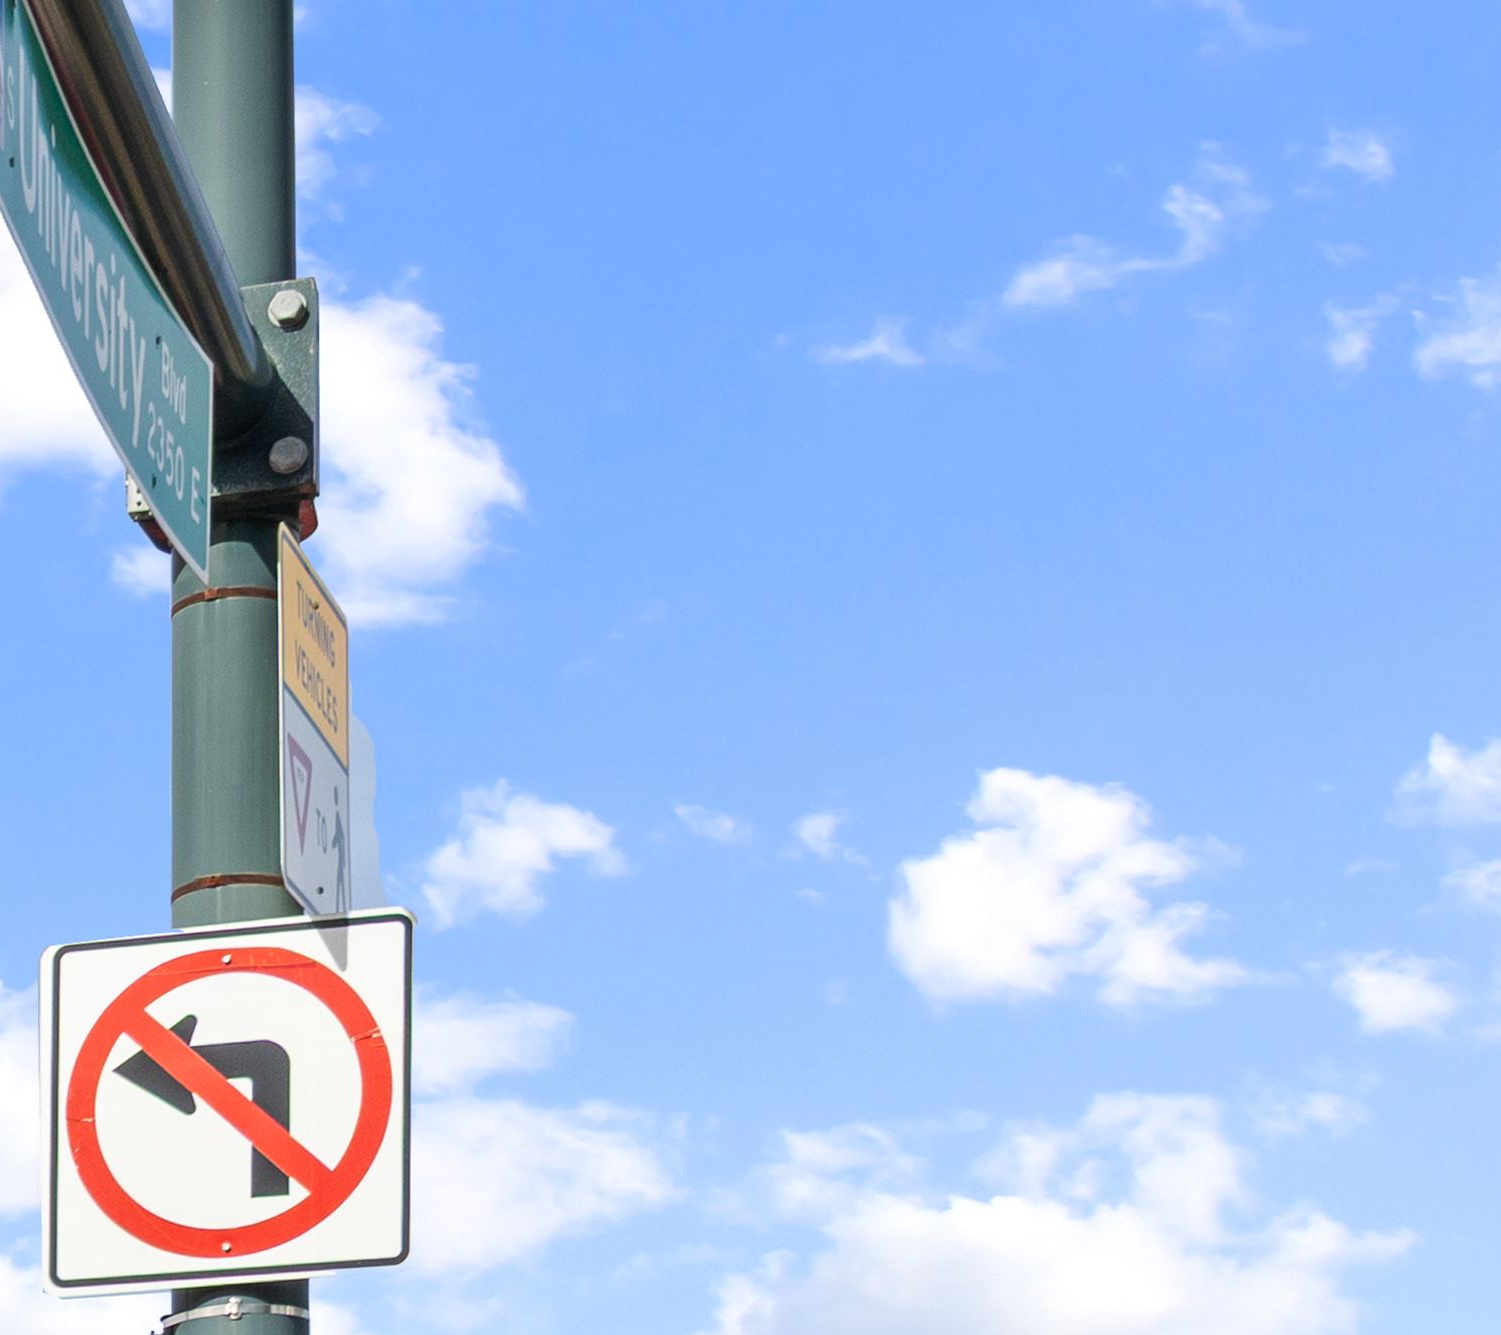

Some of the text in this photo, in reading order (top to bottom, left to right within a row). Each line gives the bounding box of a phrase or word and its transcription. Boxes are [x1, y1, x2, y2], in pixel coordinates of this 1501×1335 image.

[18, 44, 147, 450] University
[160, 340, 188, 427] Blvd
[146, 400, 201, 526] 2350 E
[295, 580, 337, 669] TURNING
[294, 638, 339, 734] VEHICLES
[314, 806, 329, 856] TO
